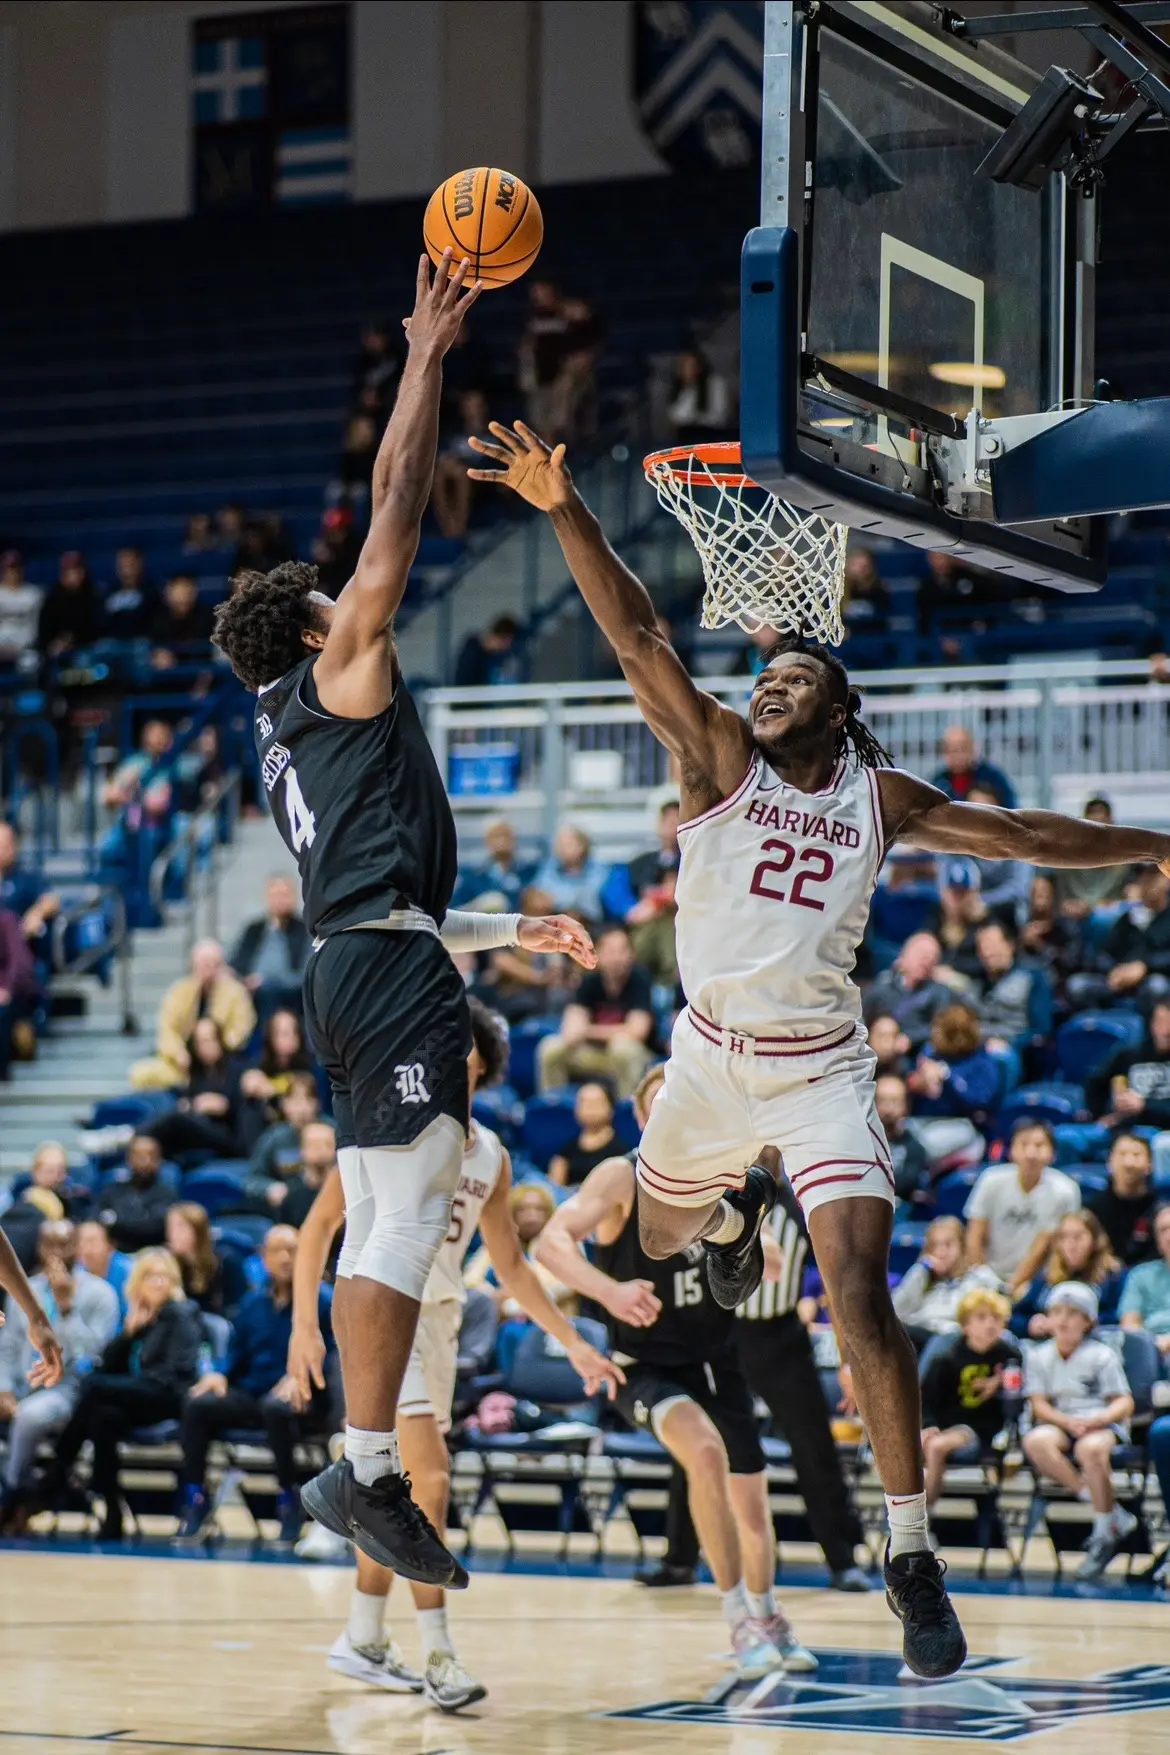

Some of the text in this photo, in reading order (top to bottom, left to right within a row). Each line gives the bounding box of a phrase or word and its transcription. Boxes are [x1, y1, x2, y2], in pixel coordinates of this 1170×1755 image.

[453, 170, 475, 221] Wil
[495, 172, 515, 213] NCA
[284, 765, 316, 853] 4
[744, 799, 860, 849] HARVARD
[749, 838, 834, 912] 22
[729, 1036, 745, 1054] H
[393, 1062, 432, 1105] R
[674, 1267, 703, 1309] 15
